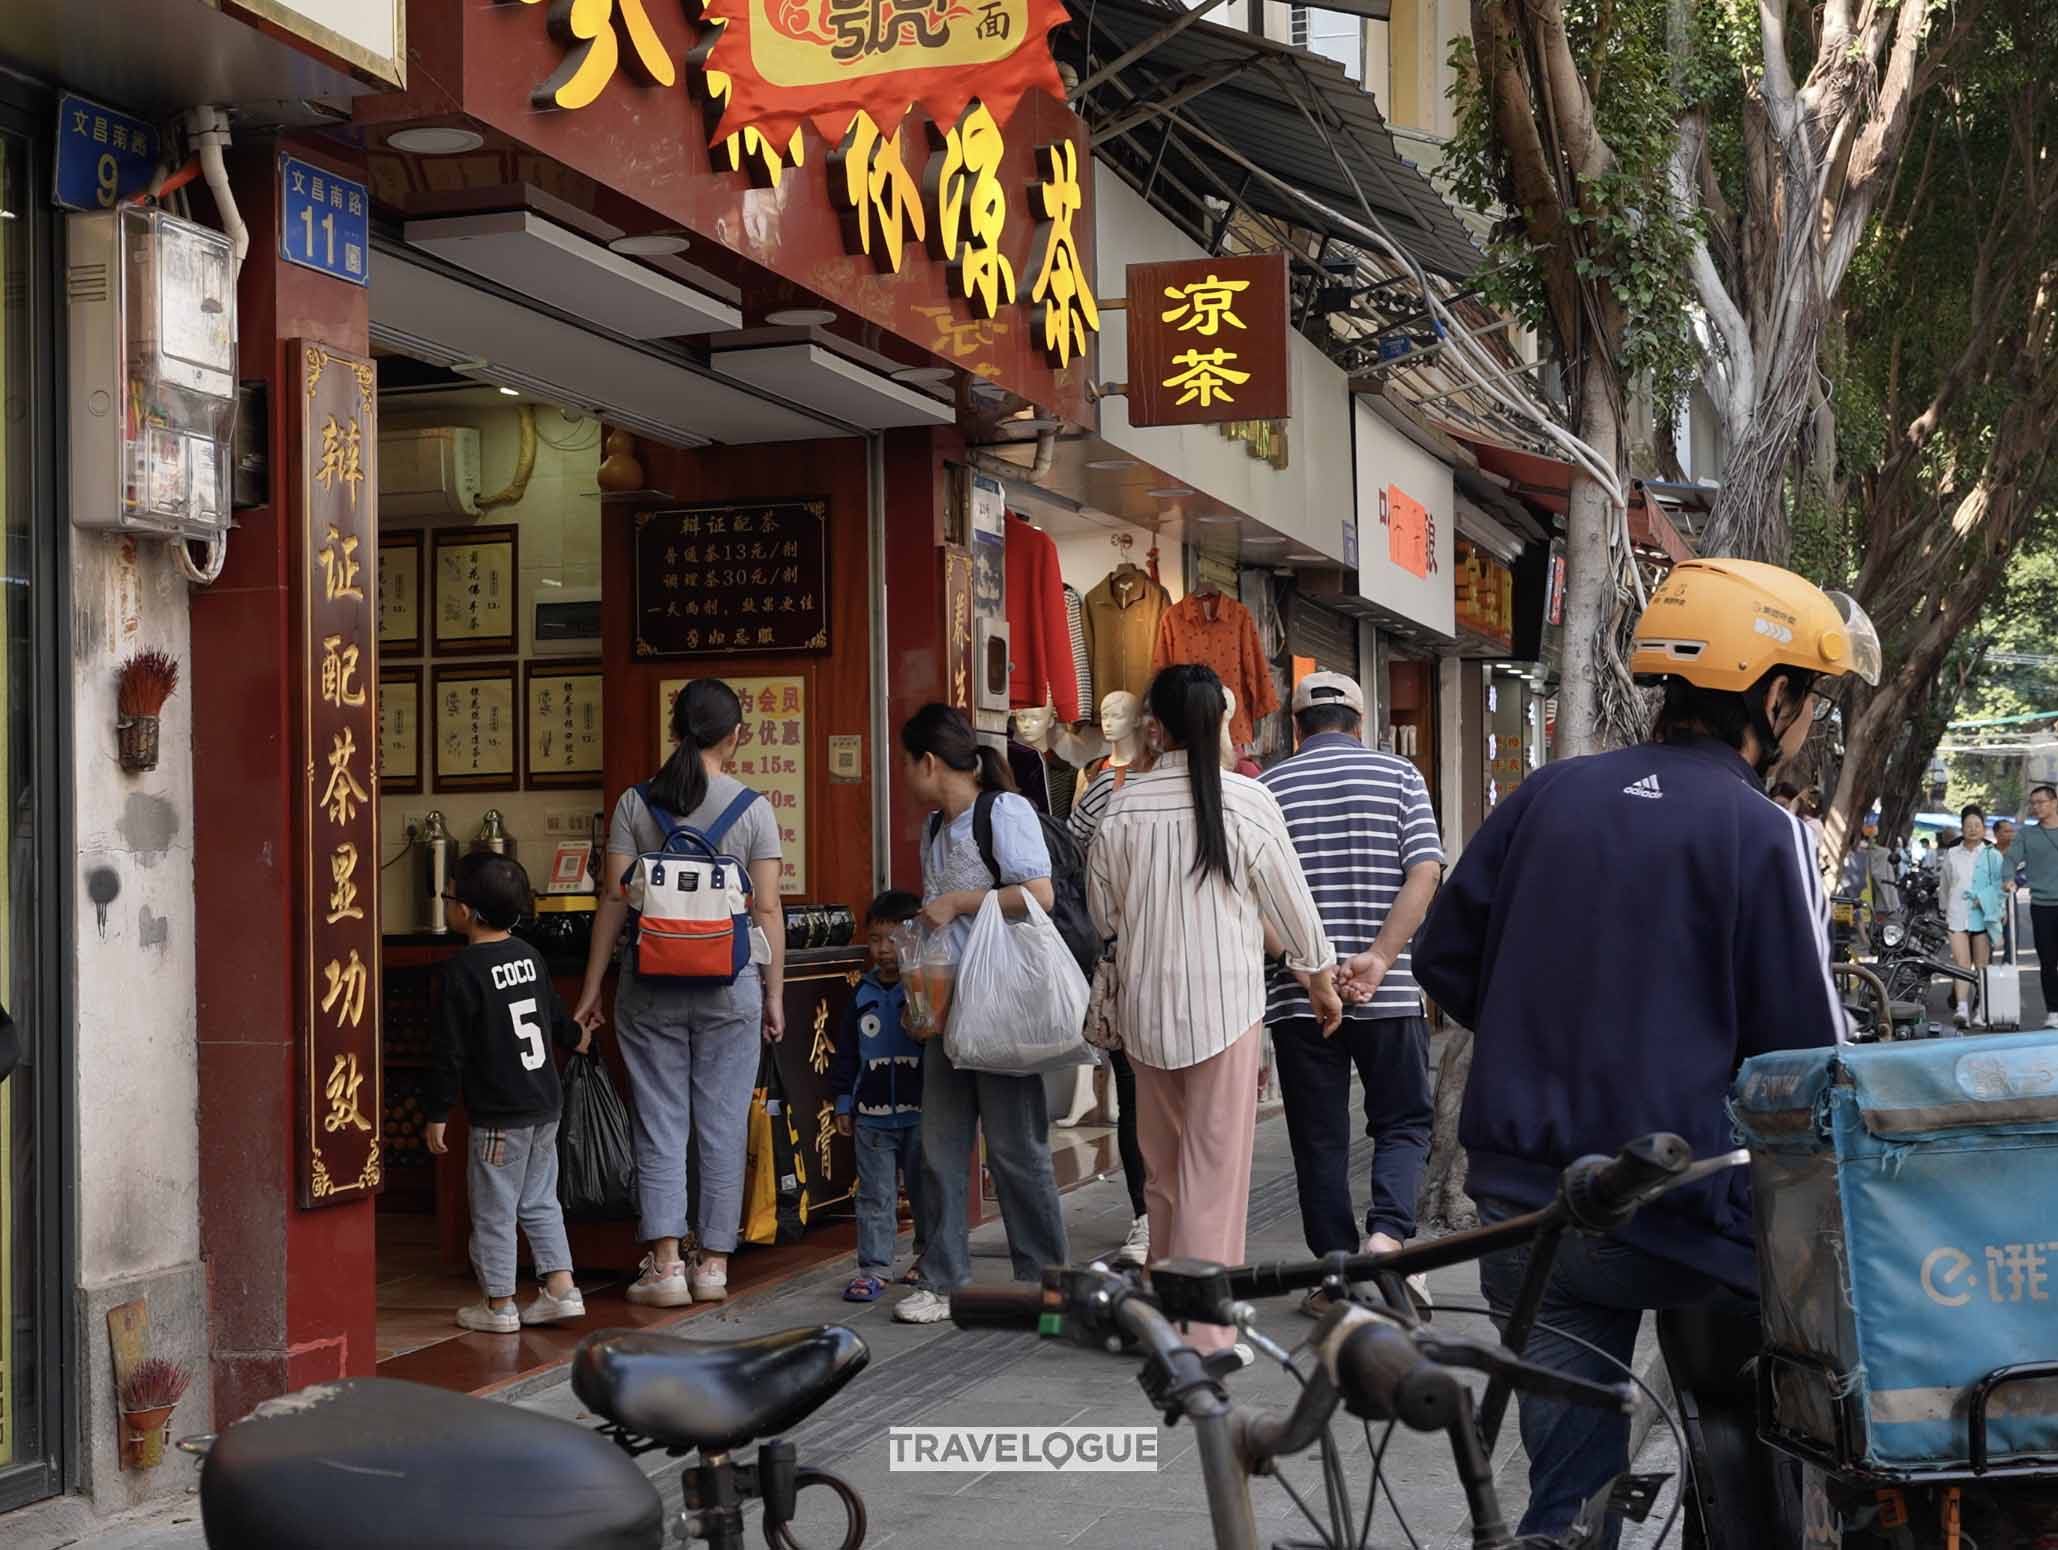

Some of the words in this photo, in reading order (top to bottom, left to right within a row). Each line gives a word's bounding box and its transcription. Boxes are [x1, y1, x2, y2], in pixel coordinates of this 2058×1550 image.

[975, 0, 1011, 40] 面
[72, 111, 148, 160] 文昌南路
[97, 153, 119, 209] 9
[291, 169, 362, 217] 文昌南路
[299, 205, 336, 266] 11
[1161, 274, 1252, 408] 凉茶
[490, 958, 537, 990] COCO
[507, 997, 547, 1072] 5
